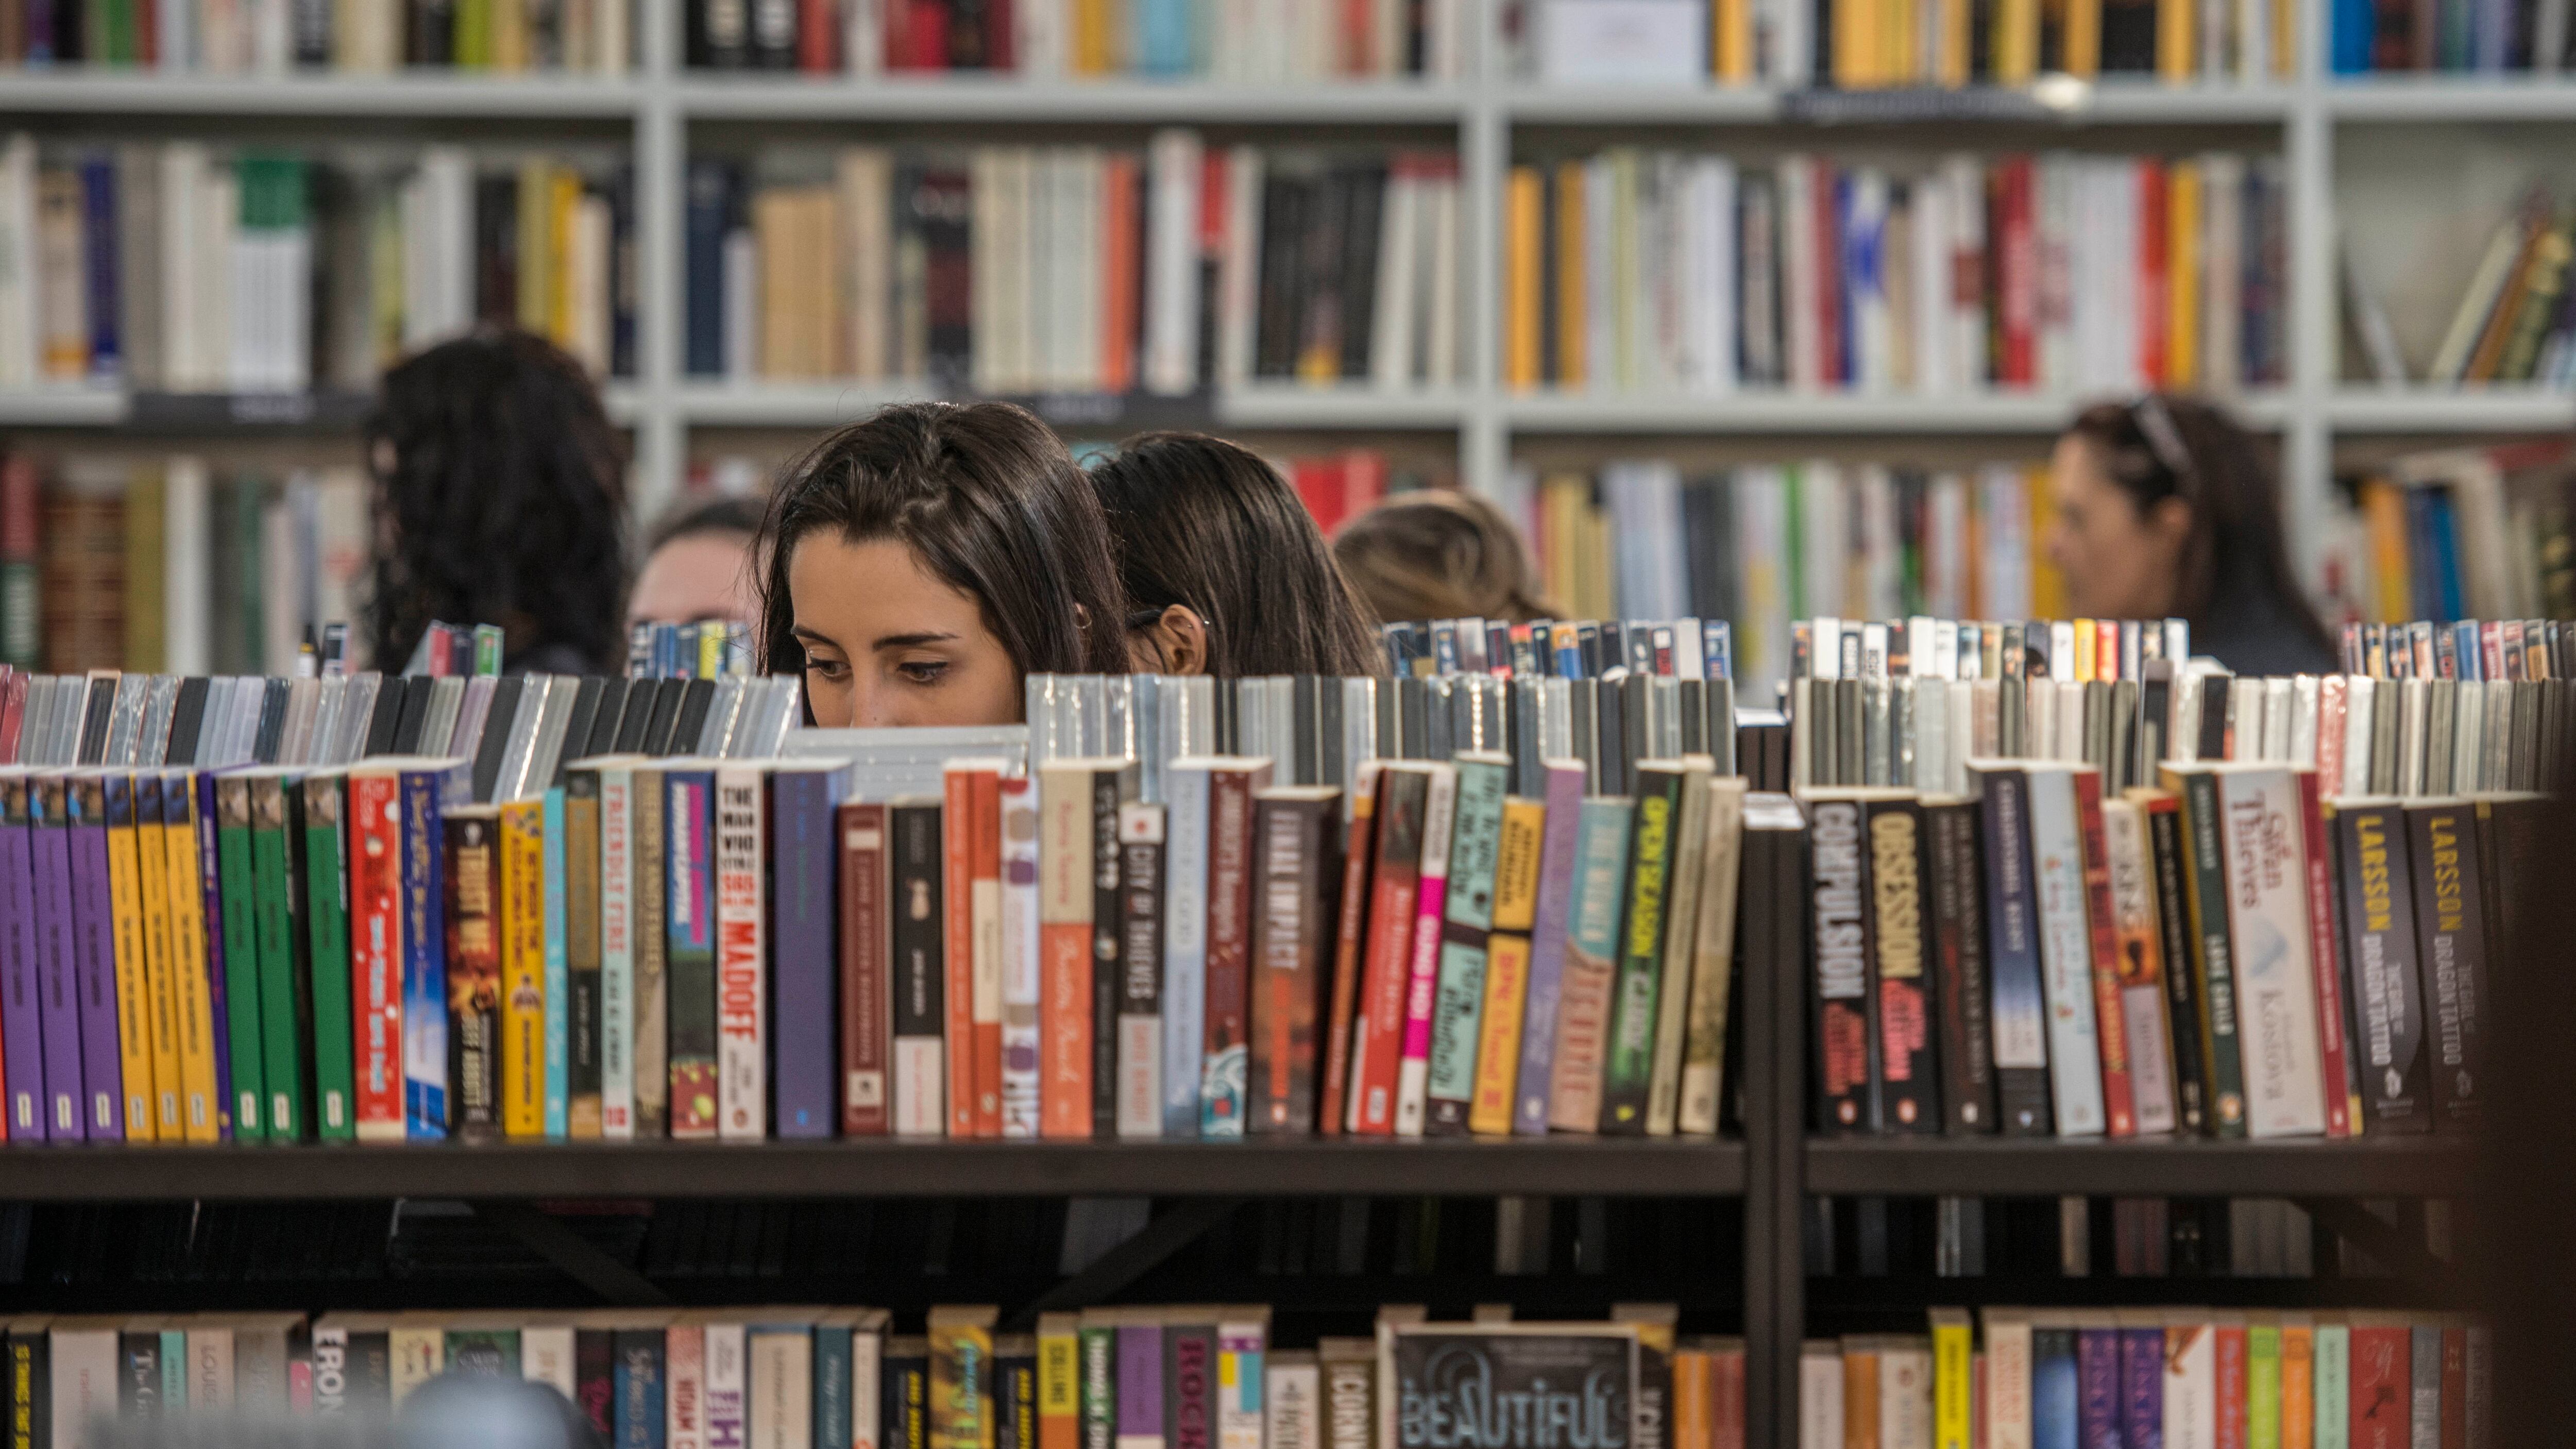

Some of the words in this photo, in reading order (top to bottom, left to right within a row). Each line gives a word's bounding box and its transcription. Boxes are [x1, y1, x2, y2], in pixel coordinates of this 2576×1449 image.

[723, 788, 752, 806] THE
[723, 813, 753, 828] MAN
[1640, 797, 1669, 861] OPEN
[607, 785, 625, 896] FRIENDLY
[723, 836, 753, 851] WHO
[1128, 848, 1155, 888] CITY
[1267, 811, 1302, 875] FINAL
[2232, 789, 2267, 911] Thieves
[2260, 813, 2286, 889] Swan
[2355, 816, 2392, 932] LARSSON
[457, 845, 490, 914] TRUST
[1130, 895, 1152, 913] OF
[1813, 803, 1866, 999] COMPULSION
[1870, 813, 1923, 979] OBSESSION
[2429, 817, 2462, 933] LARSSON
[458, 919, 490, 954] ME
[607, 902, 625, 955] FIRE
[1267, 881, 1302, 970] IMPACT
[1413, 916, 1437, 975] GUNG
[1632, 866, 1665, 957] SEASON
[722, 921, 756, 1043] MADOFF
[1128, 921, 1155, 999] THIEVES
[2205, 935, 2226, 978] LOVE
[2361, 935, 2386, 1004] DRAGON
[2433, 935, 2458, 1003] DRAGON
[2209, 984, 2234, 1035] CHILD
[2366, 1007, 2392, 1066] TATTOO
[2438, 1006, 2463, 1066] TATTOO
[2258, 992, 2287, 1101] Kostova
[1401, 1360, 1626, 1447] BEAUTIFUL
